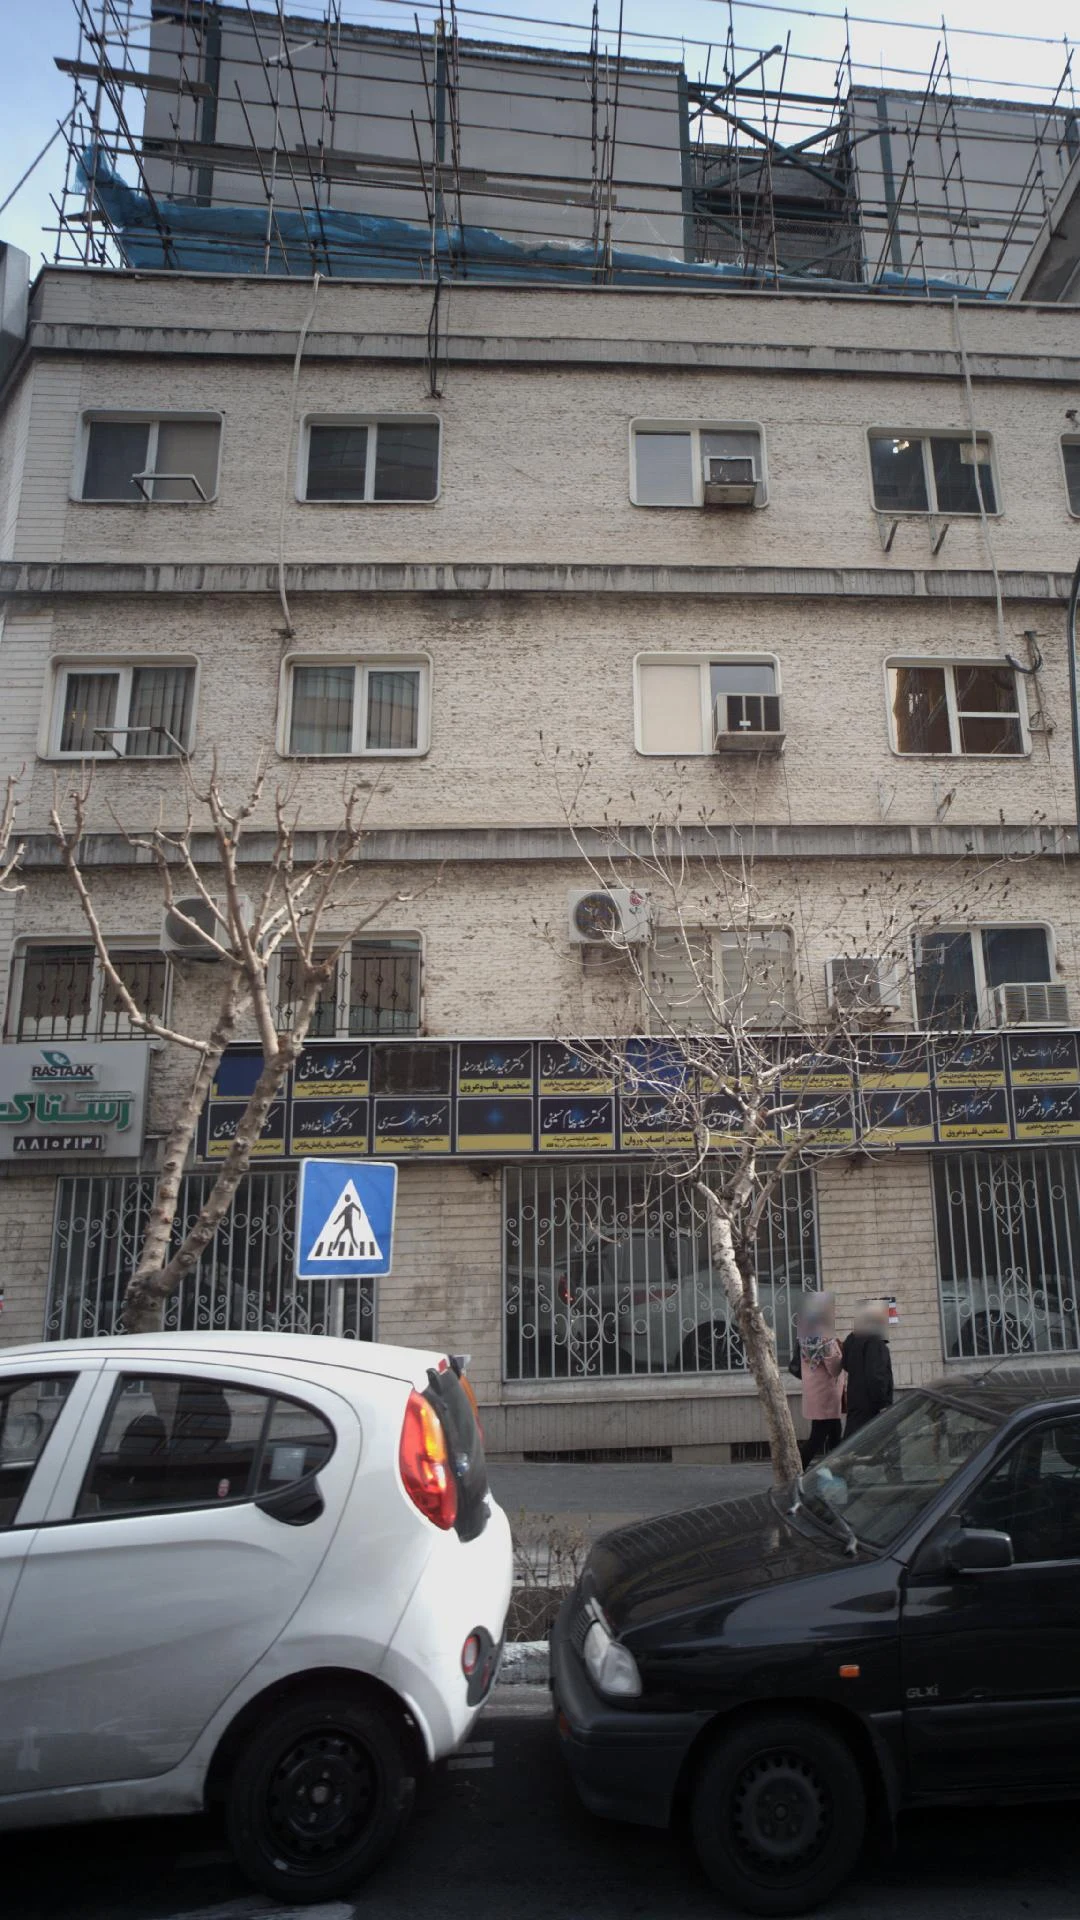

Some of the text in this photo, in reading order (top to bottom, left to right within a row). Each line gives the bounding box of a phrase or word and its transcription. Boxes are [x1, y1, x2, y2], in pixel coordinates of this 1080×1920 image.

[32, 1066, 94, 1077] RASTAAK
[299, 1049, 364, 1079] دکتر علی صادقی
[506, 1048, 530, 1074] دکتر
[460, 1083, 479, 1093] عروق
[484, 1082, 500, 1090] قلب
[498, 1081, 530, 1093] متخصص
[586, 1102, 609, 1128] دکتر
[977, 1092, 998, 1116] دکتر
[1056, 1090, 1077, 1119] دکتر
[334, 1108, 359, 1134] دکتر
[426, 1106, 447, 1128] دکتر
[906, 1685, 939, 1698] GLXi
